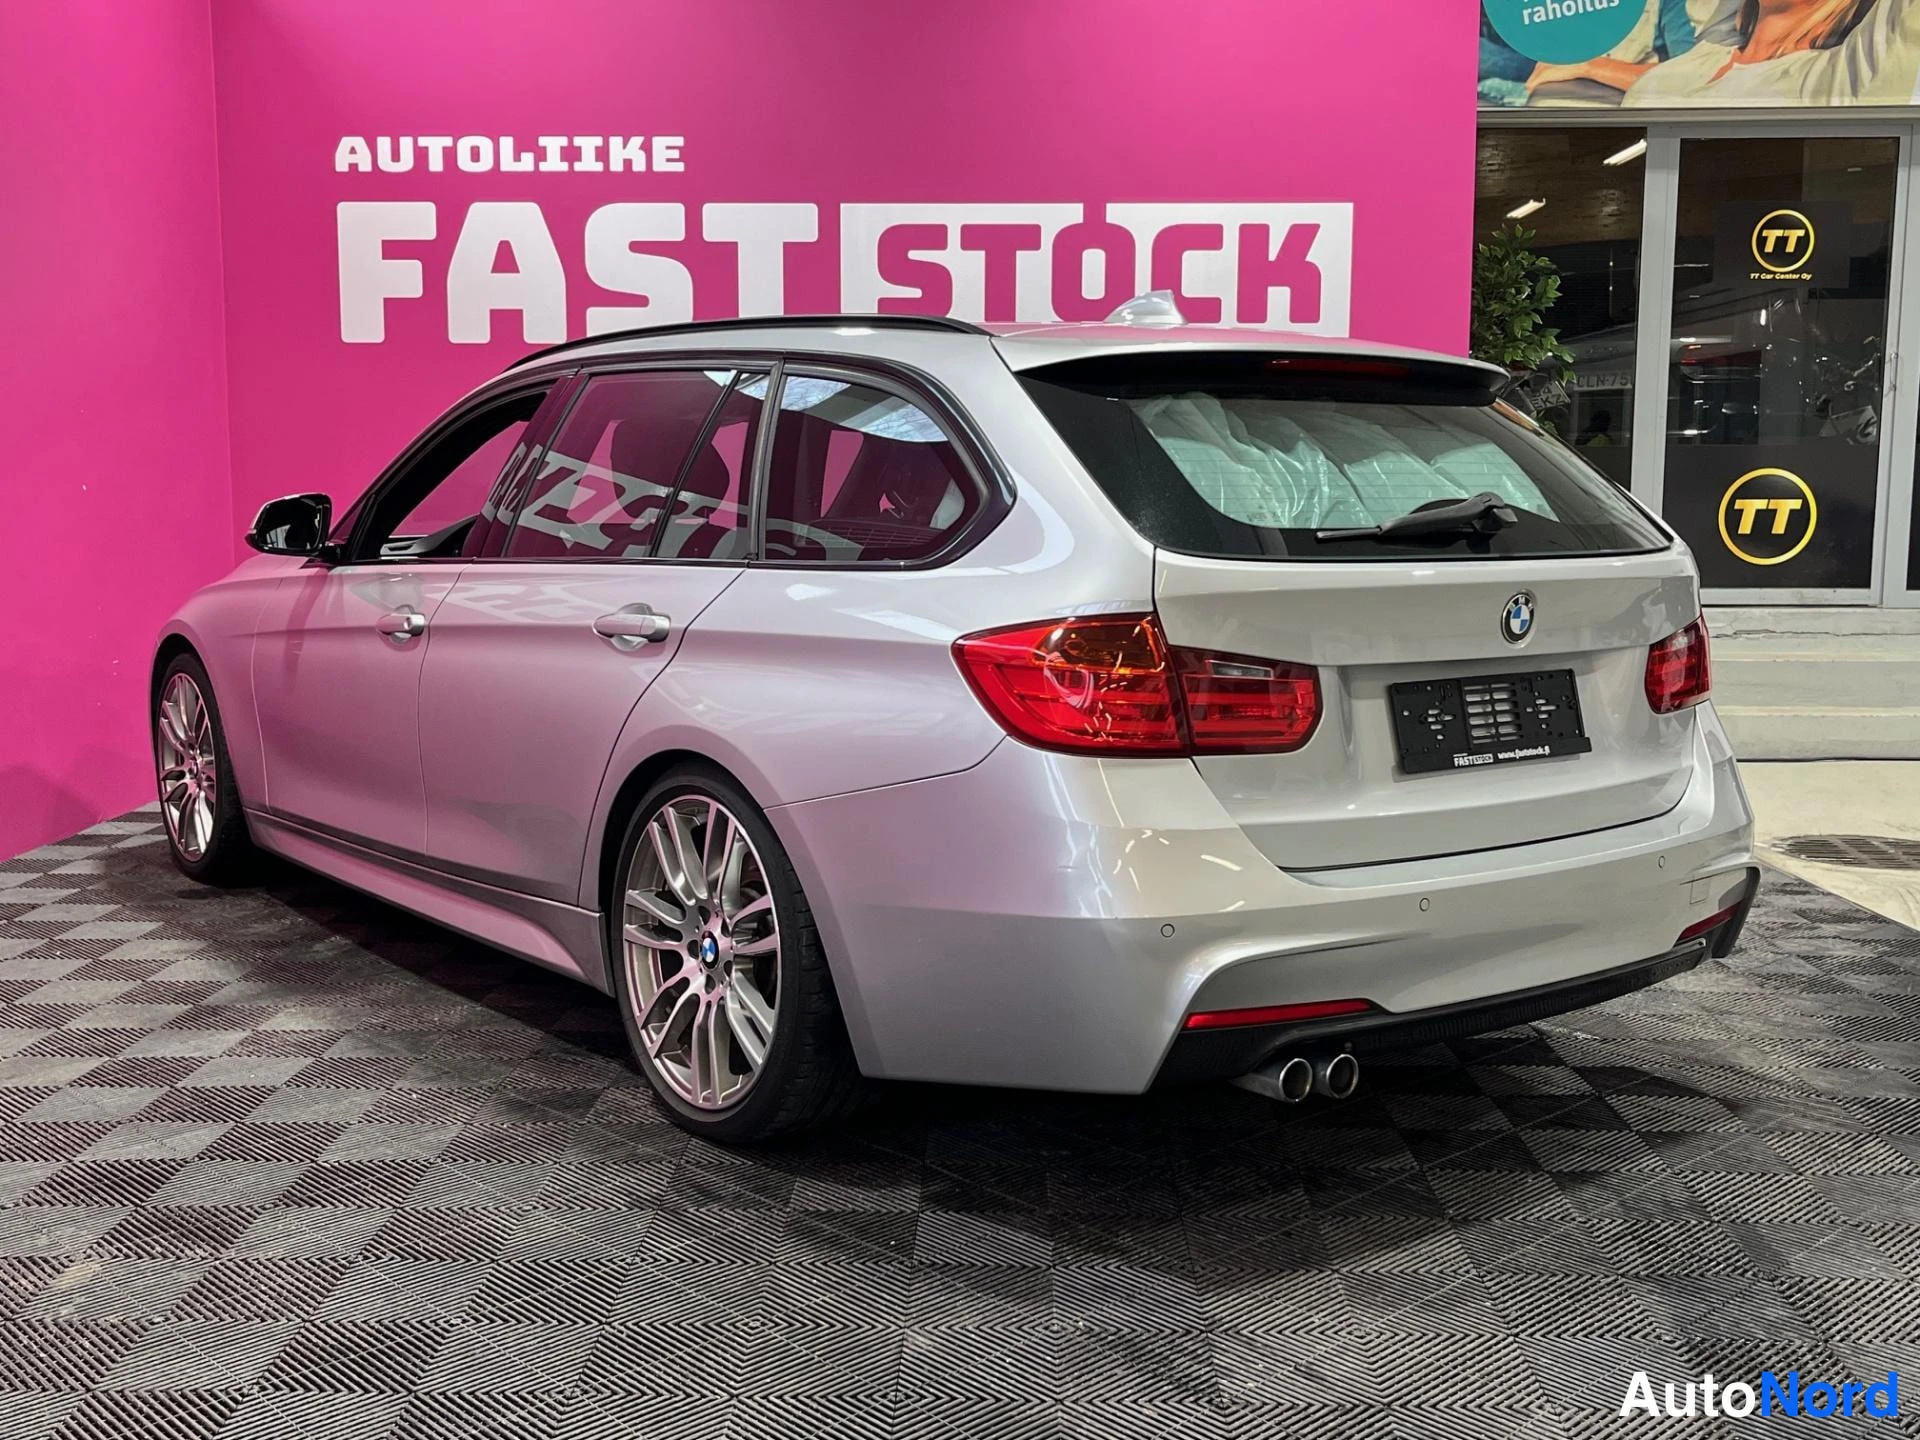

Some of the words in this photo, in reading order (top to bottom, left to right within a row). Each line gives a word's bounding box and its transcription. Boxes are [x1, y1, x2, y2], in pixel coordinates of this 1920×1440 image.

[335, 136, 685, 172] AUTOLIIKE
[1762, 229, 1805, 253] TT
[337, 202, 818, 344] FAST
[876, 220, 1321, 323] STOCK
[1577, 373, 1632, 388] CLN-75
[1734, 499, 1802, 534] TT
